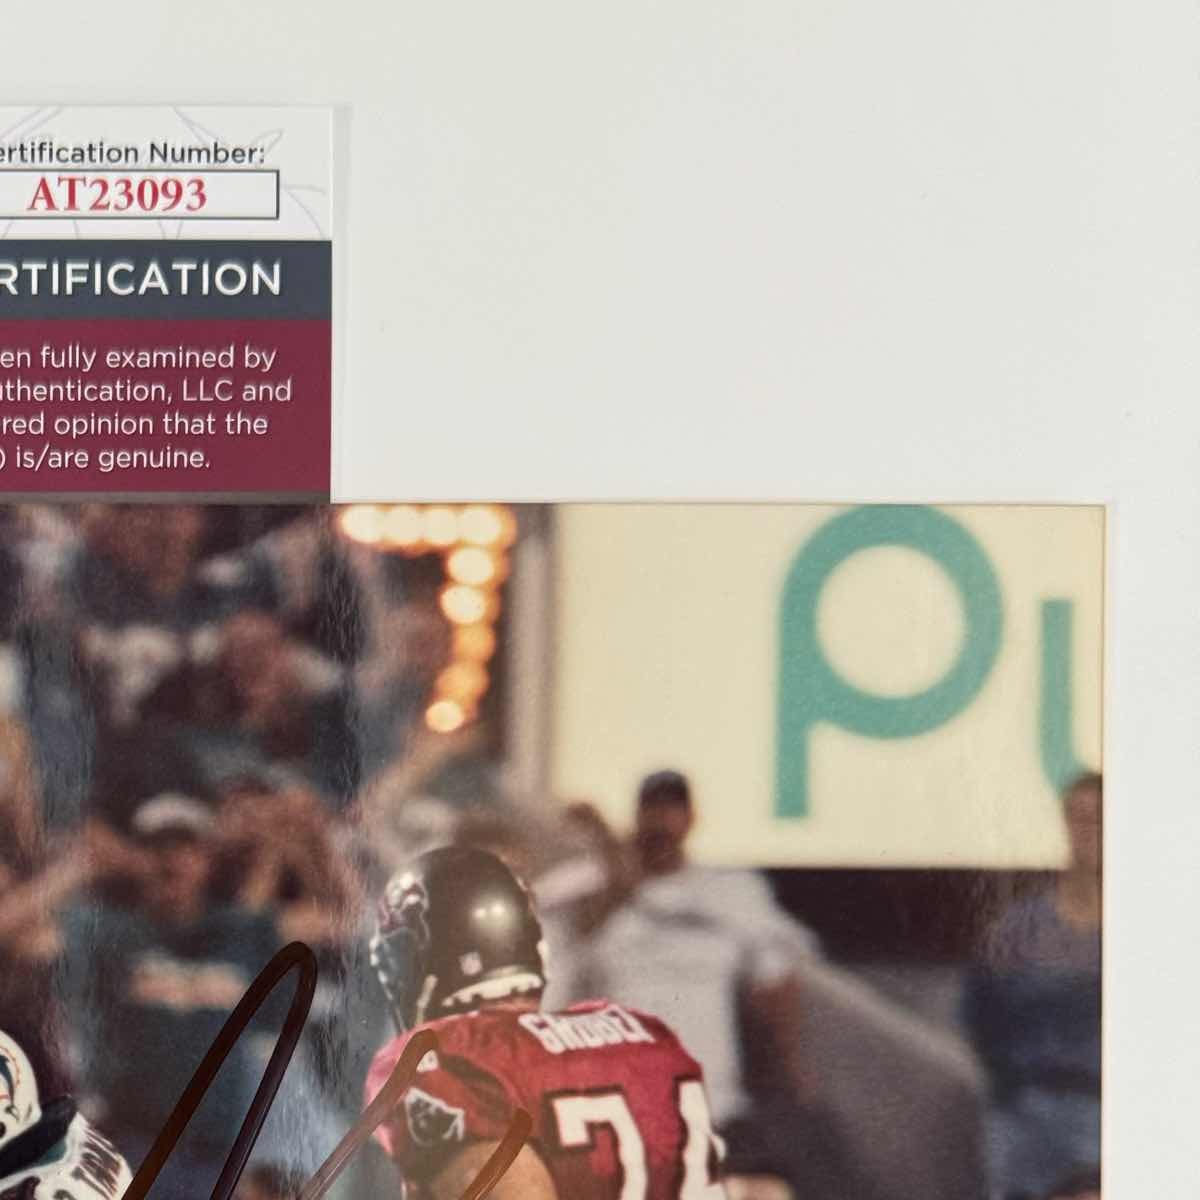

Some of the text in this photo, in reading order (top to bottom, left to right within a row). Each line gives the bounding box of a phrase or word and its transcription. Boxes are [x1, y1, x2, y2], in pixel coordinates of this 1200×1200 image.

[149, 141, 265, 164] Number:
[26, 175, 208, 213] AT23093
[40, 343, 97, 373] fully
[105, 343, 235, 369] examined
[244, 343, 277, 373] by
[182, 377, 233, 402] LLC
[241, 377, 292, 402] and
[53, 411, 154, 440] opinion
[162, 410, 217, 435] that
[224, 410, 268, 435] the
[16, 442, 89, 472] is/are
[98, 445, 210, 473] genuine.
